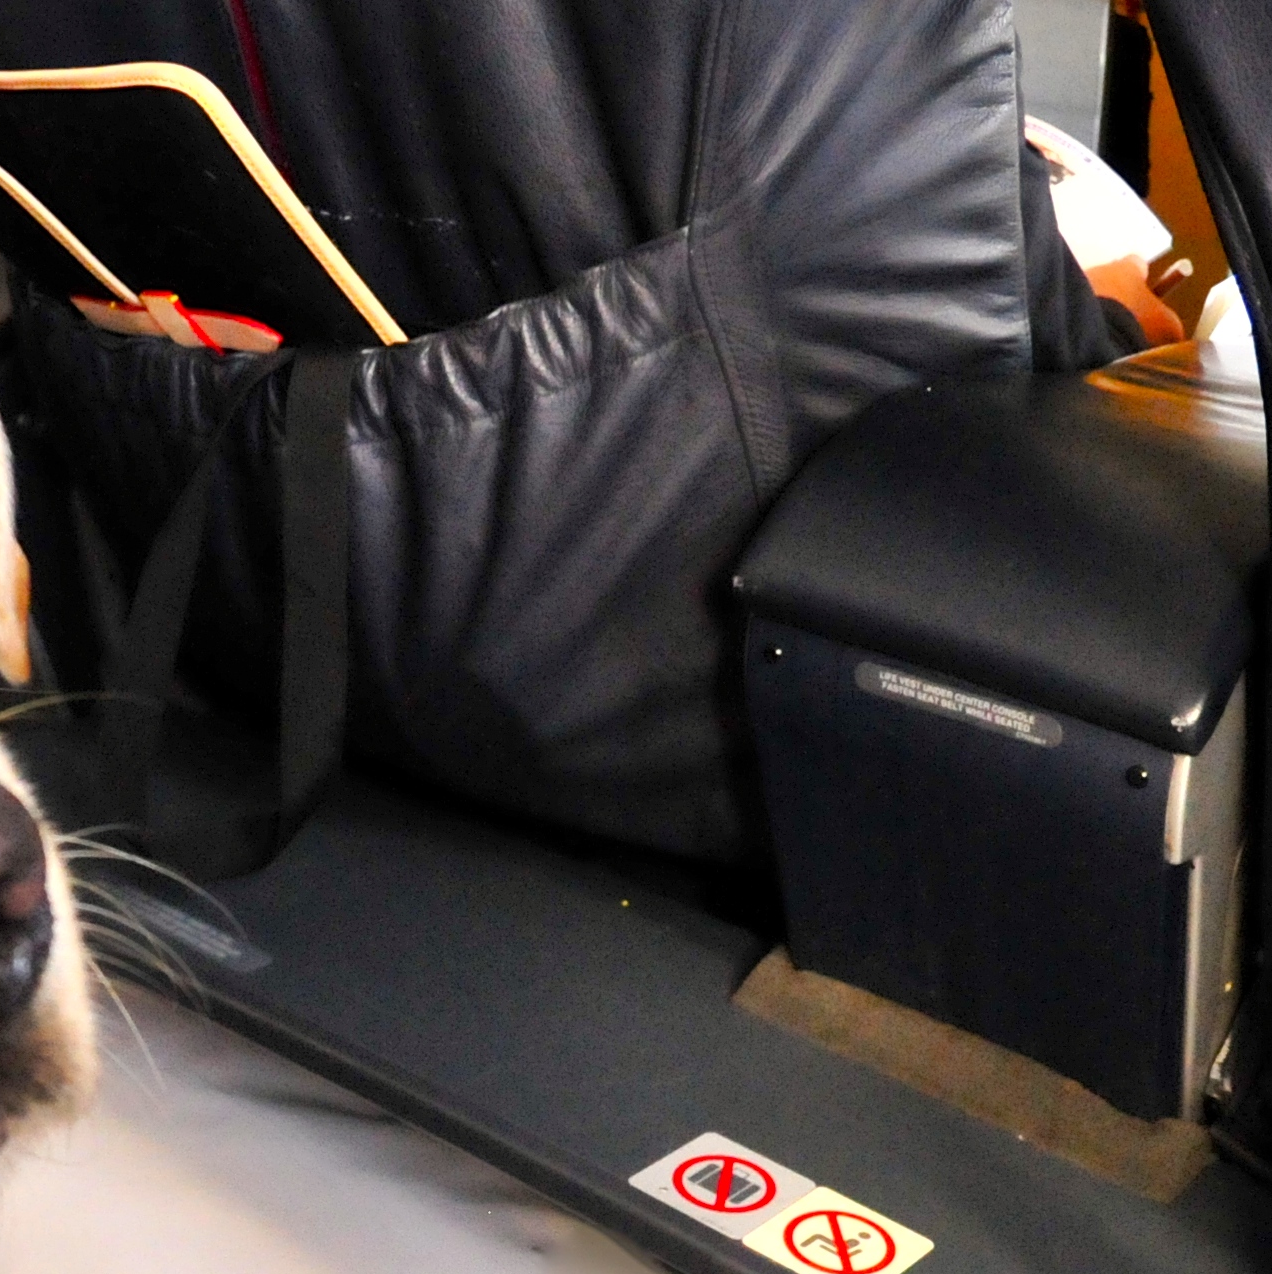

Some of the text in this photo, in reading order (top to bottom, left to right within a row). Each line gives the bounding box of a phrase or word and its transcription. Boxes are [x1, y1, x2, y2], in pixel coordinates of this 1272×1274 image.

[877, 669, 1036, 724] LIFE VEST UNDER CENTER CONSOLE
[880, 680, 1031, 733] FASTEN SEAT BELT WHILE SEATED
